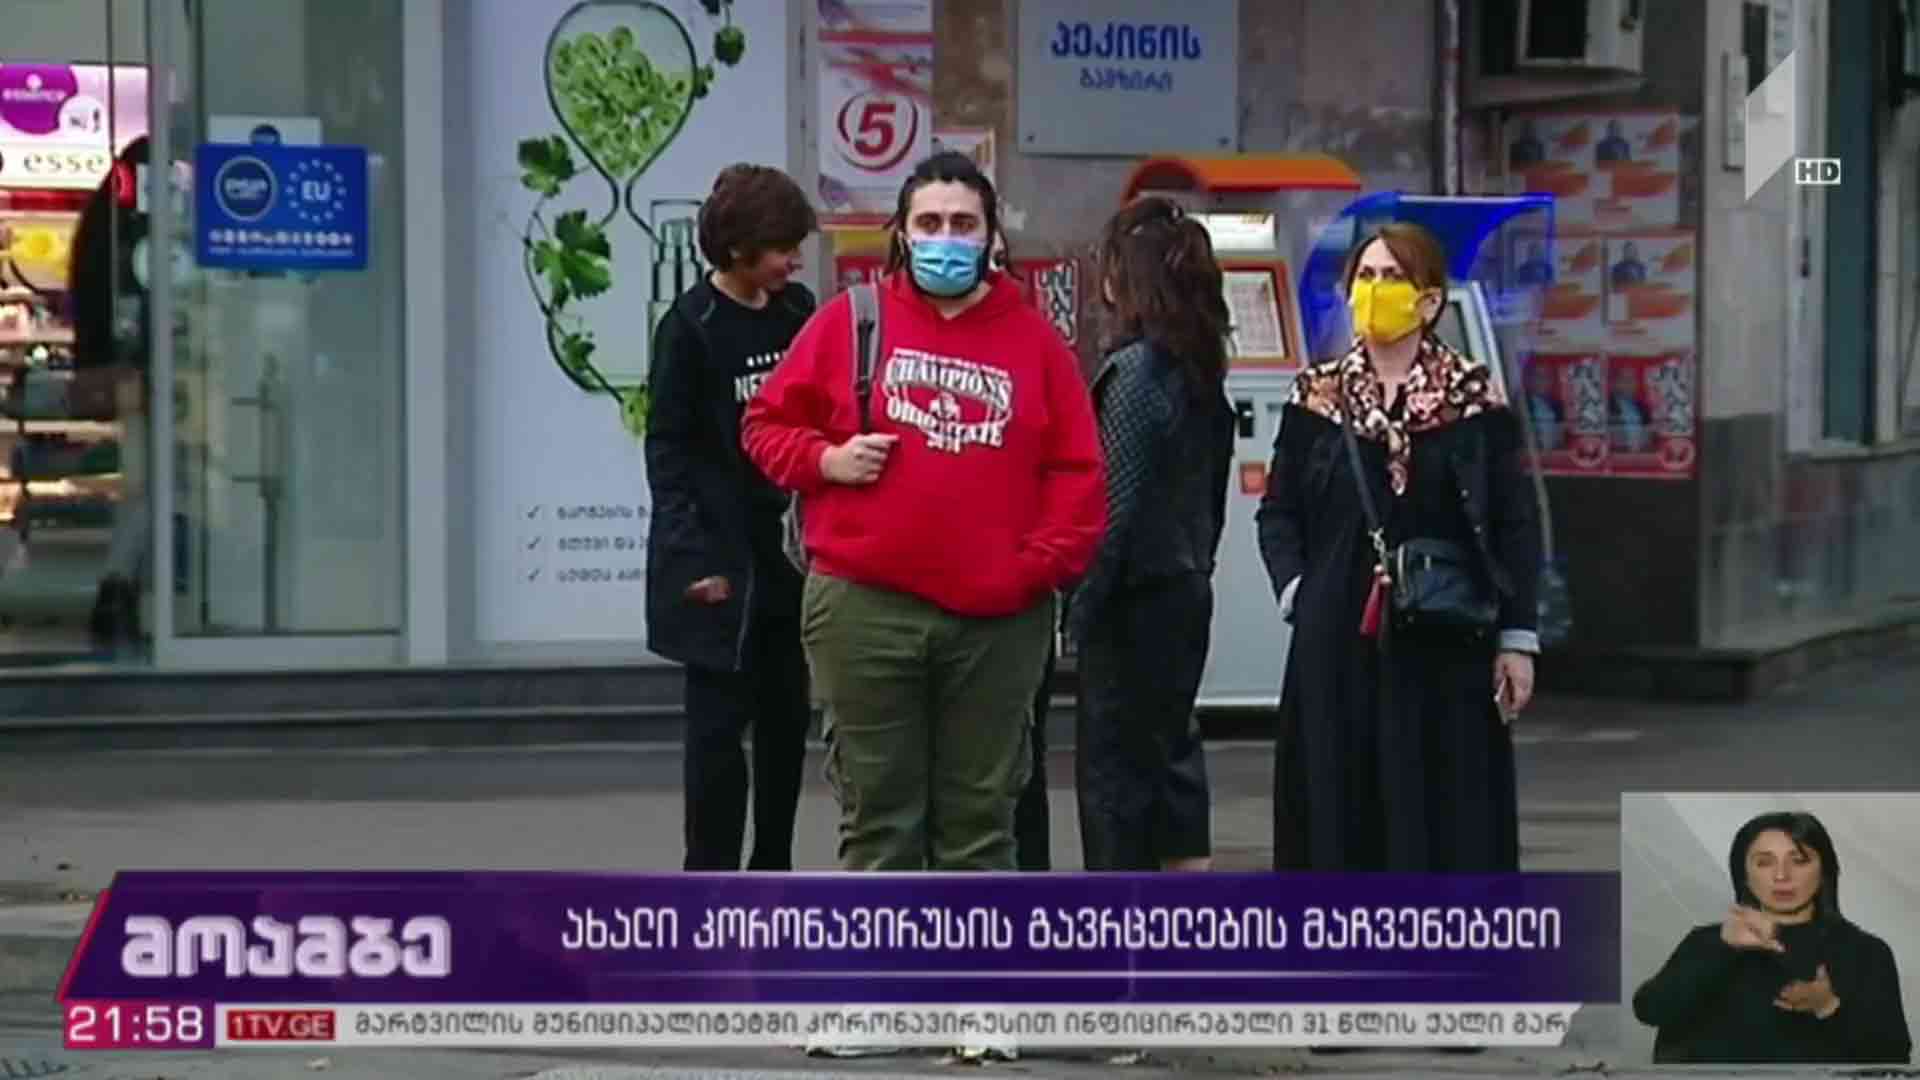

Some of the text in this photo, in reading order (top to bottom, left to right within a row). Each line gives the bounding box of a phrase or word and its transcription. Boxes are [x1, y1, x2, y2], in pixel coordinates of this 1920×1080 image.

[1051, 21, 1202, 60] პეკინის
[854, 102, 896, 157] 5
[302, 180, 332, 201] EU
[885, 354, 1012, 411] CHAMPIONS
[887, 395, 938, 430] OHIO
